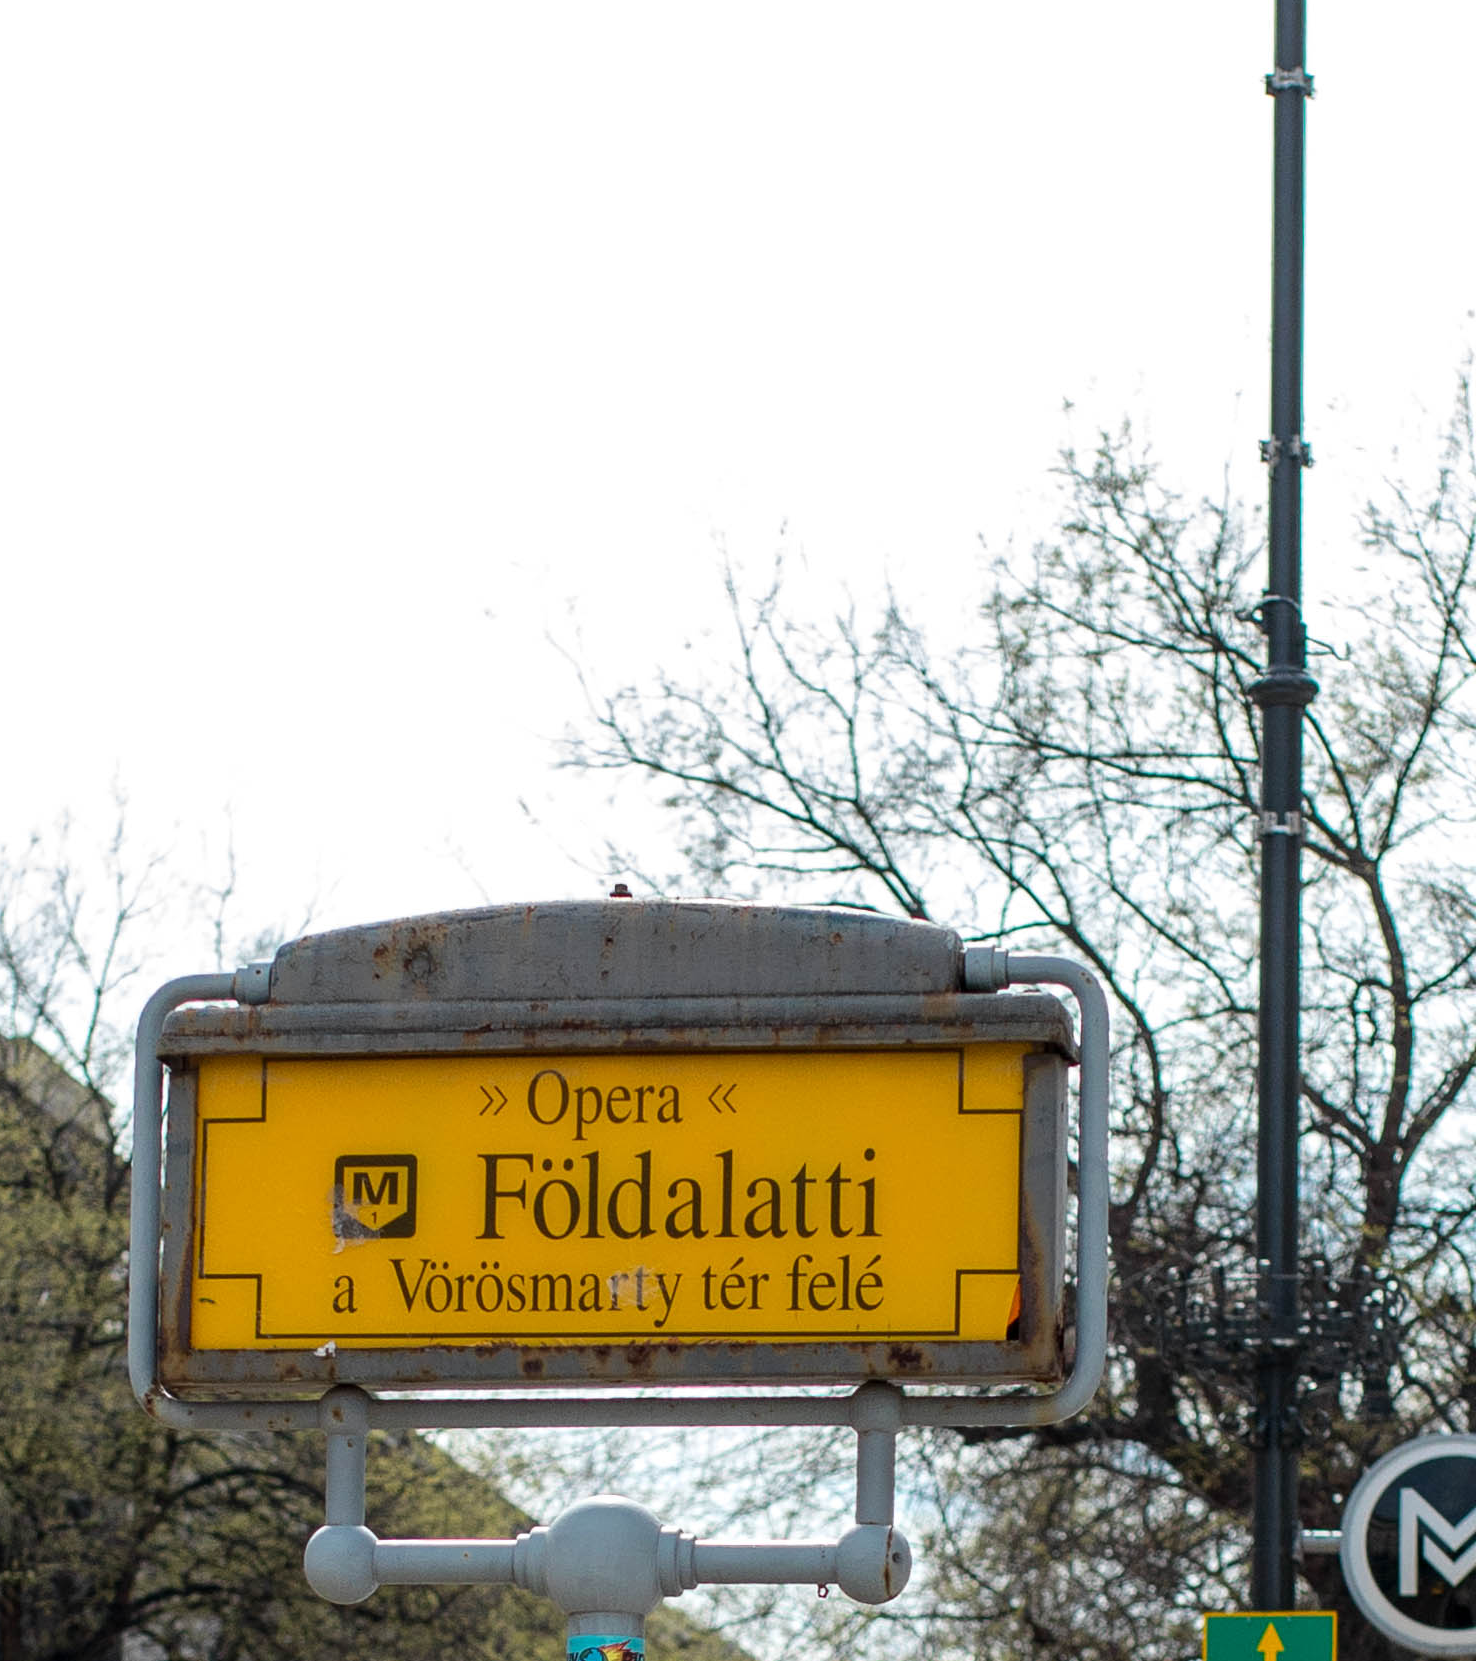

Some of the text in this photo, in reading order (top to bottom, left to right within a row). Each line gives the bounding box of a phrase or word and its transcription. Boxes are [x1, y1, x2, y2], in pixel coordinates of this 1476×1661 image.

[527, 1068, 684, 1141] Opera
[353, 1172, 399, 1205] M
[371, 1211, 378, 1225] 1
[475, 1147, 883, 1240] Földalatti
[332, 1253, 885, 1328] a Vörösmarty tér felé
